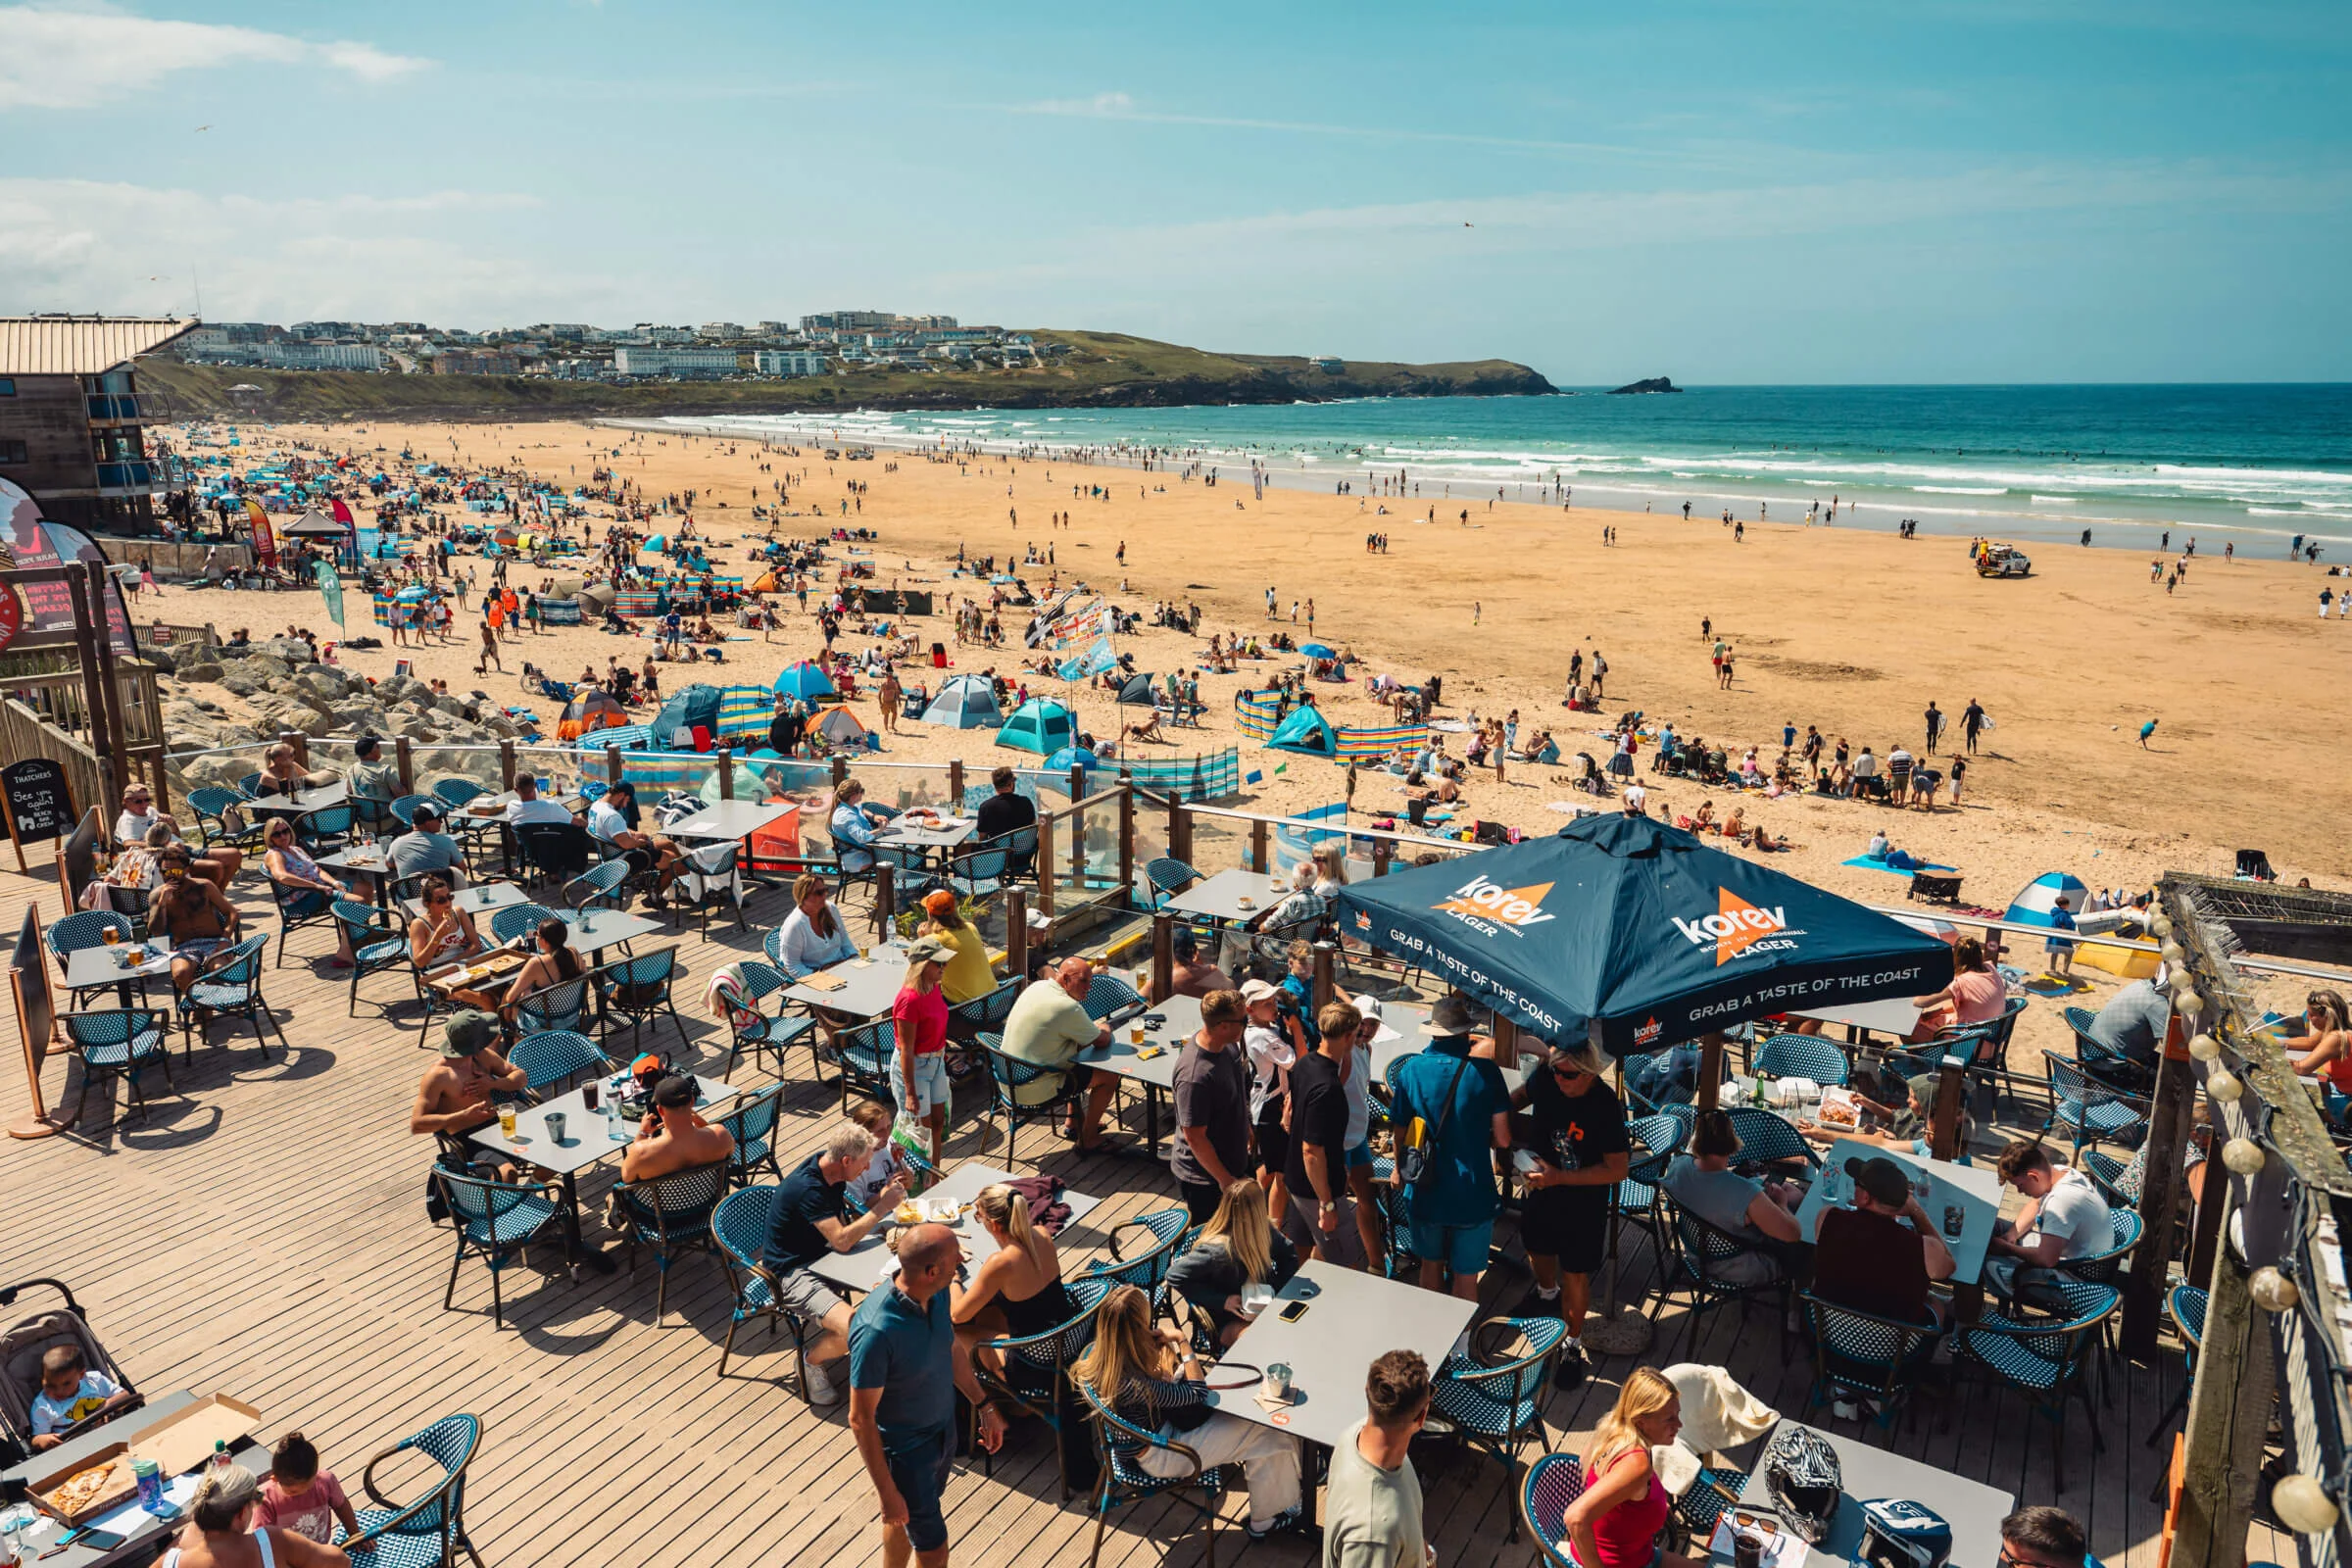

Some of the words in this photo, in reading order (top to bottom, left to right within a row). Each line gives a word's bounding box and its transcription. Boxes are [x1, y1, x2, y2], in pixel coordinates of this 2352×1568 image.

[14, 771, 52, 783] THATCHERS
[14, 791, 33, 803] See
[36, 790, 52, 801] you
[1455, 875, 1556, 925] korev
[1446, 906, 1497, 938] LAGER
[1670, 906, 1787, 945] korev
[1761, 929, 1808, 938] CORNWALL
[1730, 939, 1799, 958] LAGER
[1390, 929, 1424, 951] GRAB
[1426, 944, 1434, 956] A
[1436, 949, 1469, 977] TASTE
[1471, 970, 1489, 987] OF
[1491, 980, 1517, 1004] THE
[1519, 998, 1562, 1033] COAST
[1689, 998, 1739, 1022] GRAB
[1741, 995, 1753, 1007] A
[1756, 981, 1808, 1003] TASTE
[1812, 977, 1834, 992] OF
[1838, 973, 1870, 989] THE
[1874, 967, 1922, 984] COAST
[1634, 1021, 1663, 1039] korev
